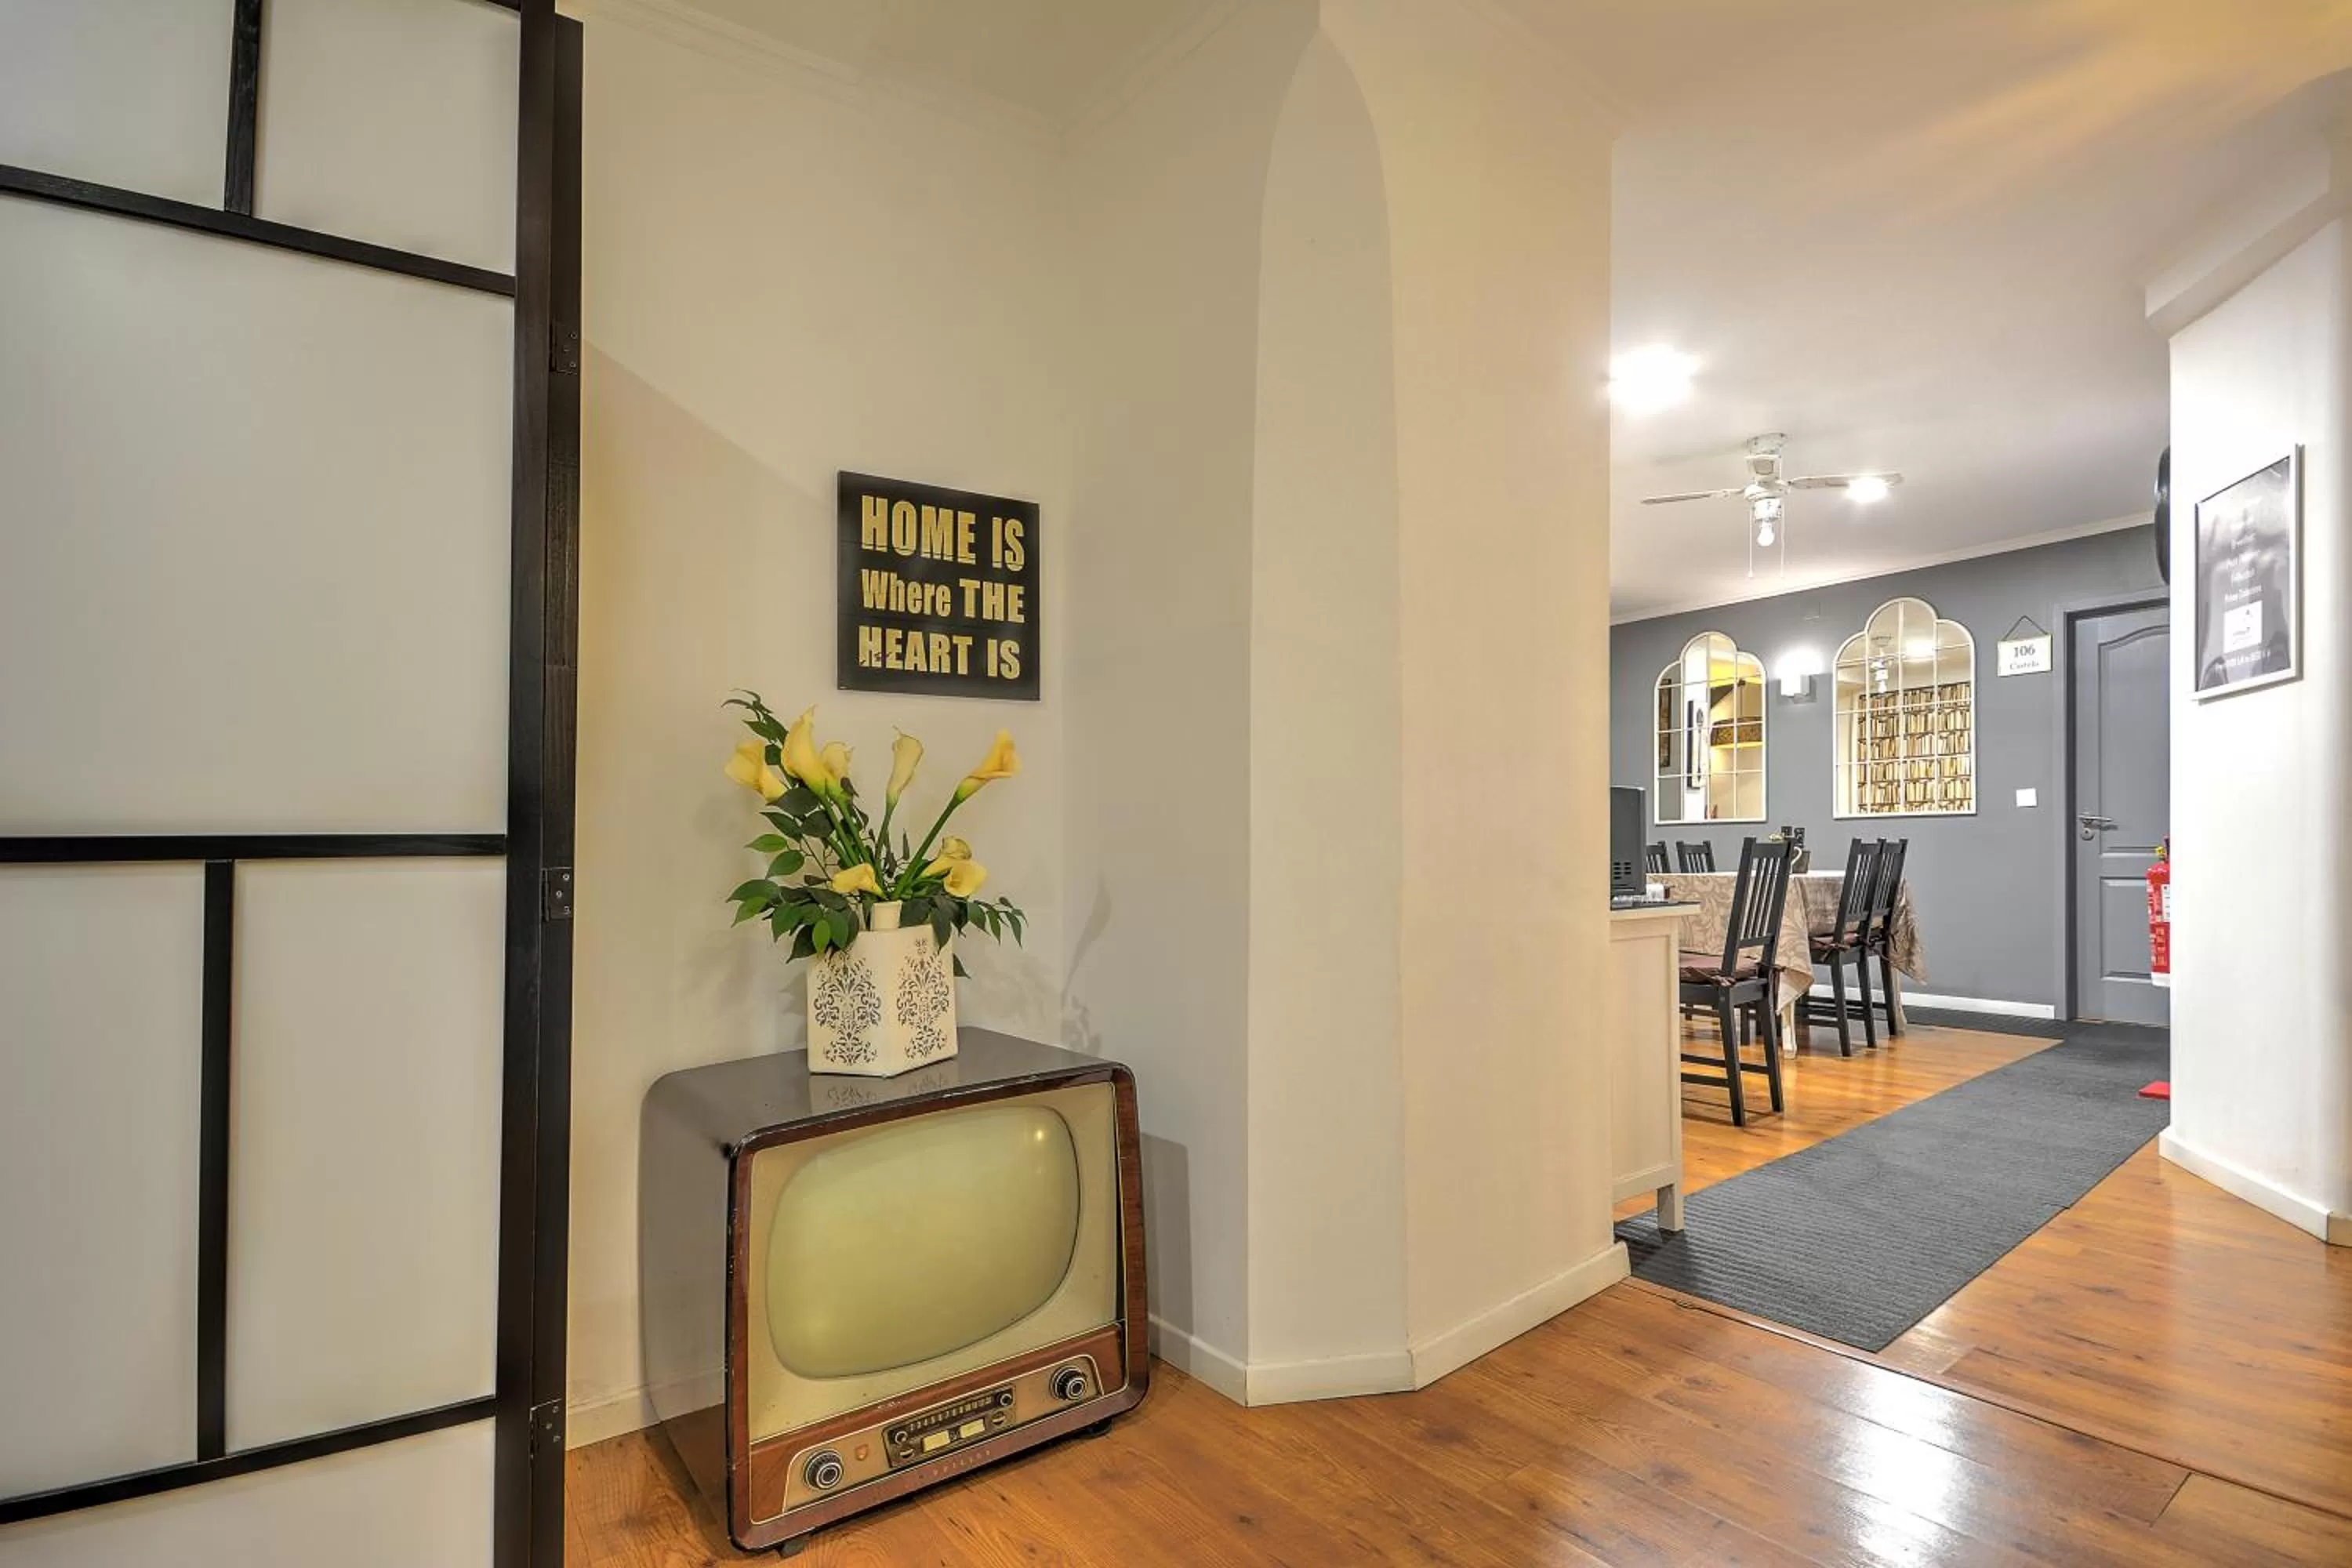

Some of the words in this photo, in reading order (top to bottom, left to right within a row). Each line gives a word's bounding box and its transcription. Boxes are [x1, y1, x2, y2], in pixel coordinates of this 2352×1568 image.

[861, 495, 976, 565] HOME
[992, 517, 1025, 572] IS
[860, 568, 951, 618] Where
[959, 578, 1025, 624] THE
[858, 625, 973, 676] HEART
[986, 638, 1021, 680] IS
[2013, 644, 2036, 658] 106
